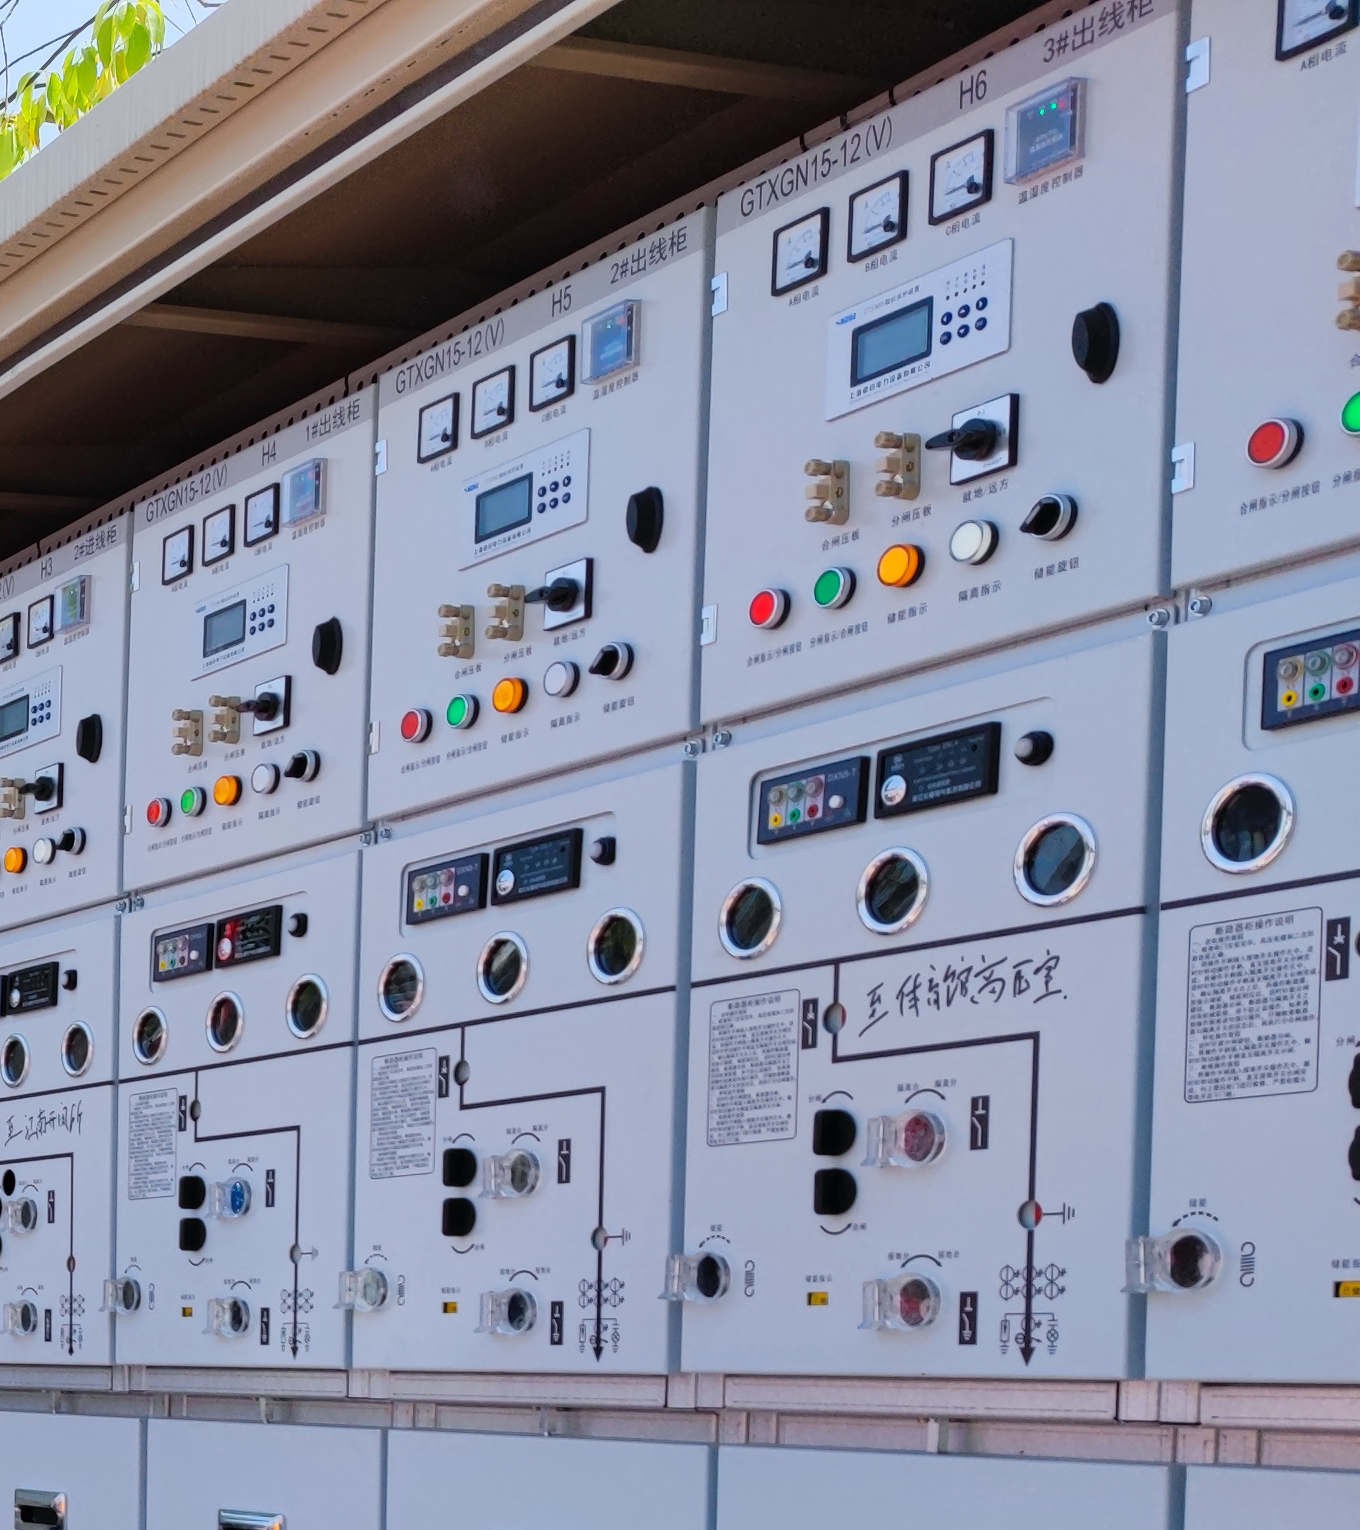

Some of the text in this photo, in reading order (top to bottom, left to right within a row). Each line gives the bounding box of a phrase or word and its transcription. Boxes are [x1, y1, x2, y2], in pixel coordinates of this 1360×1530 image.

[740, 0, 1155, 219] GTXGN15-12(V) H6 3#出线柜
[395, 226, 688, 395] GTXGN15-12(V) H5 2#出线柜
[145, 398, 361, 523] GTXGN15-12(V) H4 1#出线柜
[41, 557, 53, 580] H3
